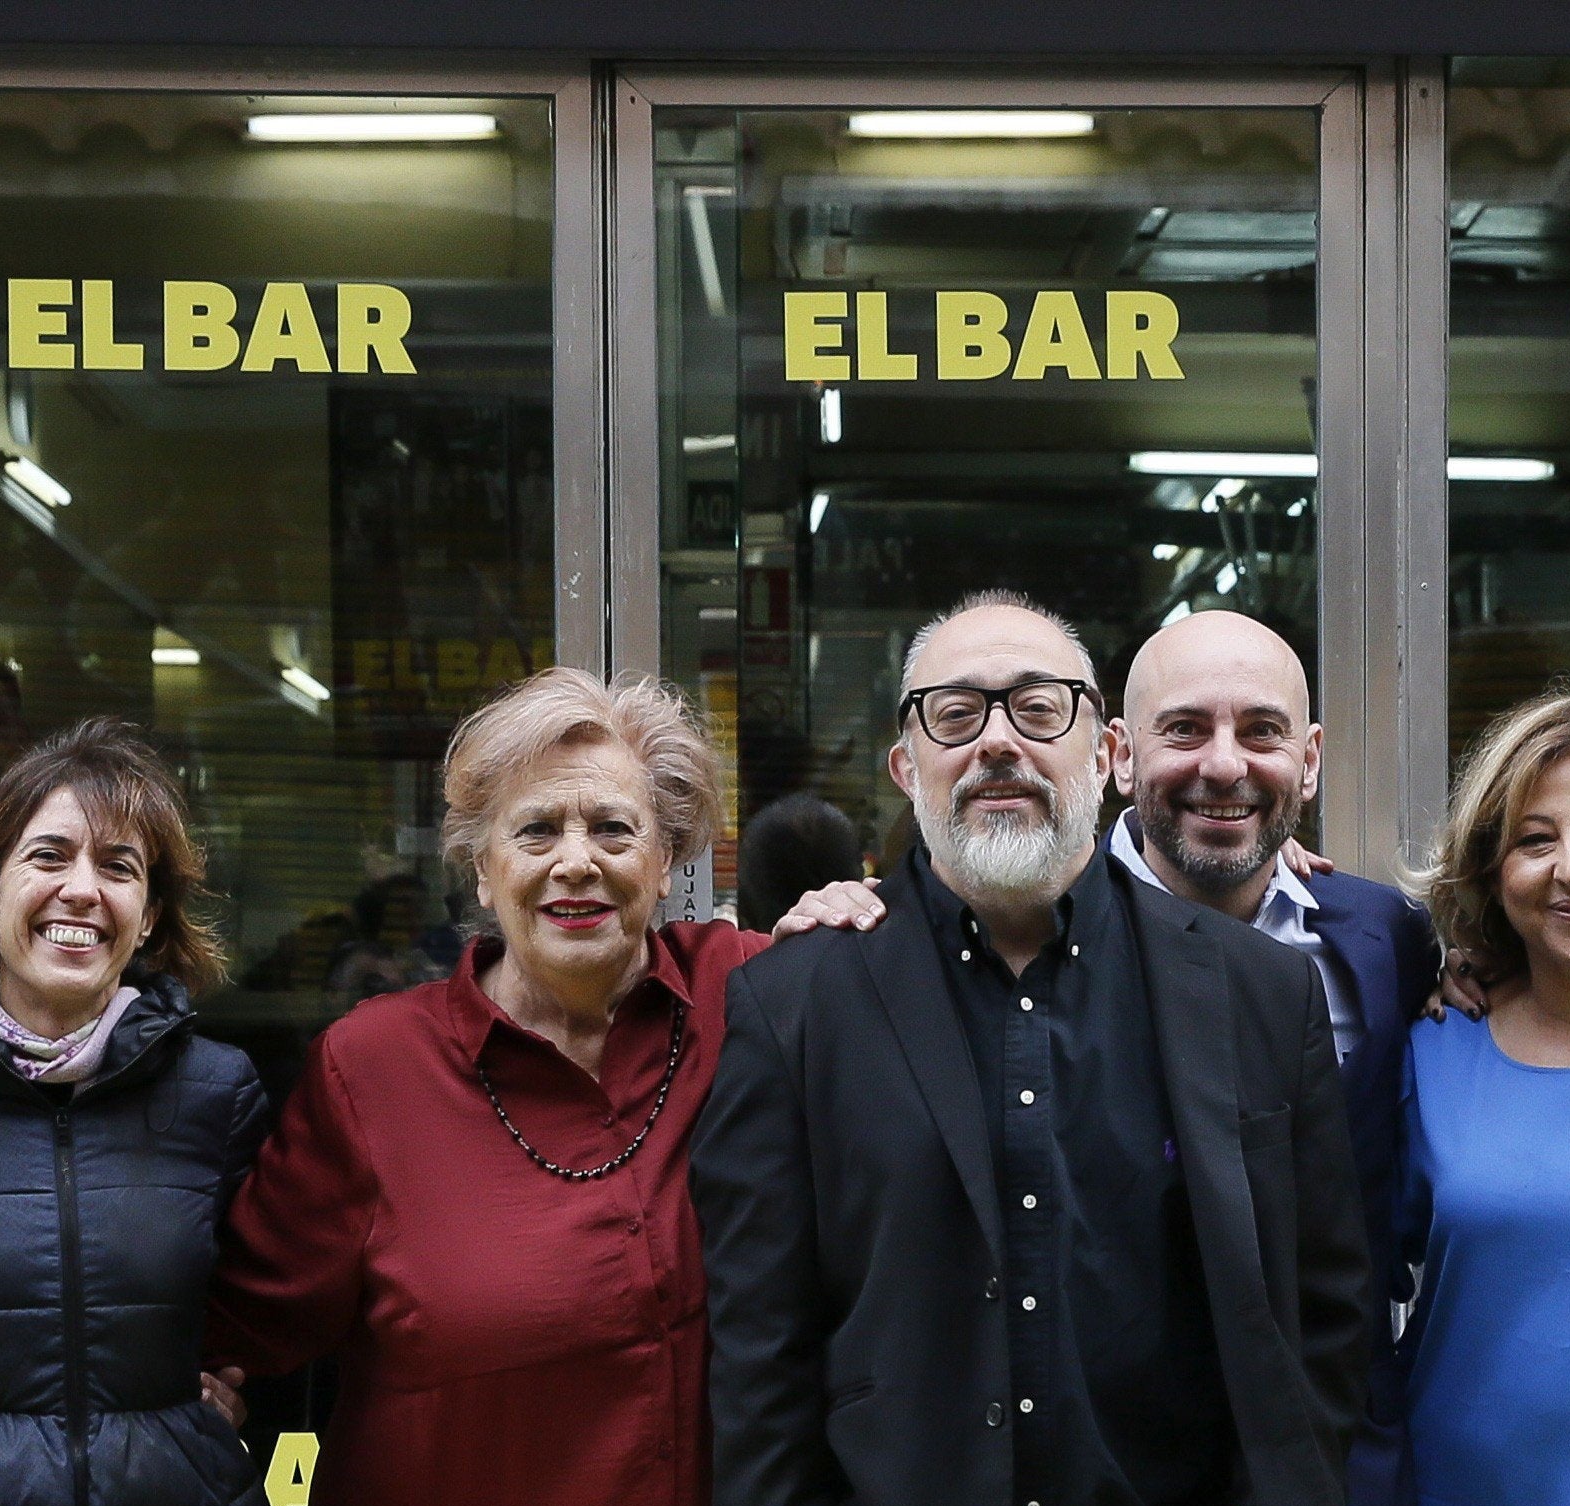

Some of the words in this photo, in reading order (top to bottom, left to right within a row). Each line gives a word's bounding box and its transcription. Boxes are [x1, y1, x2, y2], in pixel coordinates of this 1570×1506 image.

[8, 278, 144, 370] EL
[164, 280, 416, 374] BAR
[784, 291, 918, 381] EL
[936, 290, 1185, 380] BAR
[353, 638, 428, 690] EL
